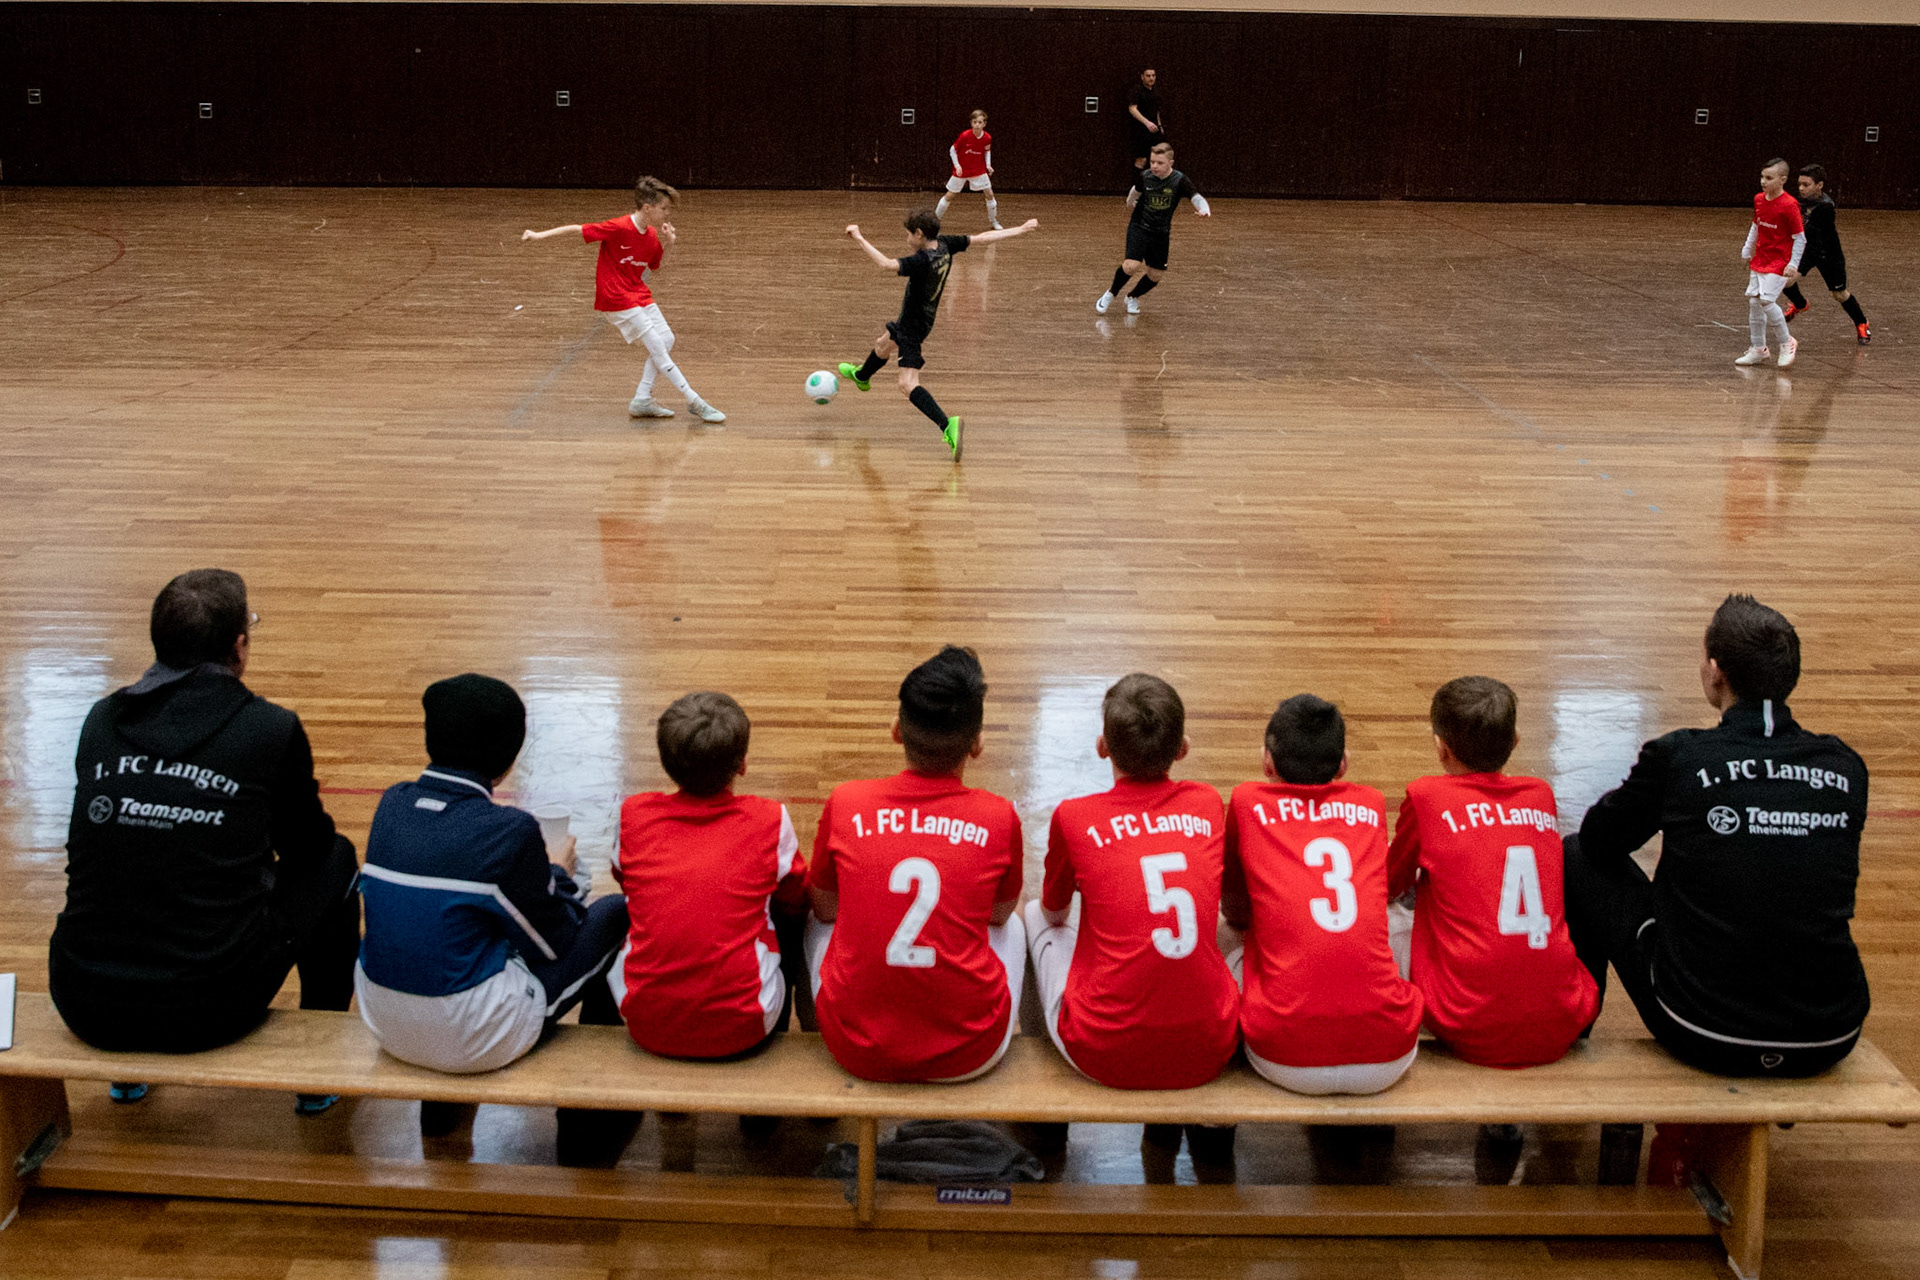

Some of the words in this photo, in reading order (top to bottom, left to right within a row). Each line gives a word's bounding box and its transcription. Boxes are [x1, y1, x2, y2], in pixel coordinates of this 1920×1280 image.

[930, 263, 949, 301] 7
[95, 763, 110, 780] 1.
[118, 756, 148, 774] FC
[154, 759, 239, 795] Langen
[1696, 768, 1721, 788] 1.
[1726, 759, 1757, 781] FC
[1764, 759, 1849, 793] Langen
[118, 816, 173, 829] Rhein-Main
[119, 798, 225, 825] Teamsport
[852, 813, 872, 838] 1.
[877, 808, 904, 834] FC
[911, 808, 989, 847] Langen
[1086, 825, 1111, 848] 1.
[1110, 814, 1140, 840] FC
[1142, 811, 1212, 838] Langen
[1253, 803, 1276, 826] 1.
[1278, 798, 1305, 822] FC
[1308, 799, 1379, 828] Langen
[1441, 810, 1466, 833] 1.
[1465, 802, 1495, 827] FC
[1745, 807, 1849, 829] Teamsport
[1749, 825, 1809, 836] Rhein-Main
[1303, 836, 1358, 933] 3
[1497, 845, 1551, 949] 4
[886, 857, 942, 968] 2
[1140, 851, 1199, 960] 5
